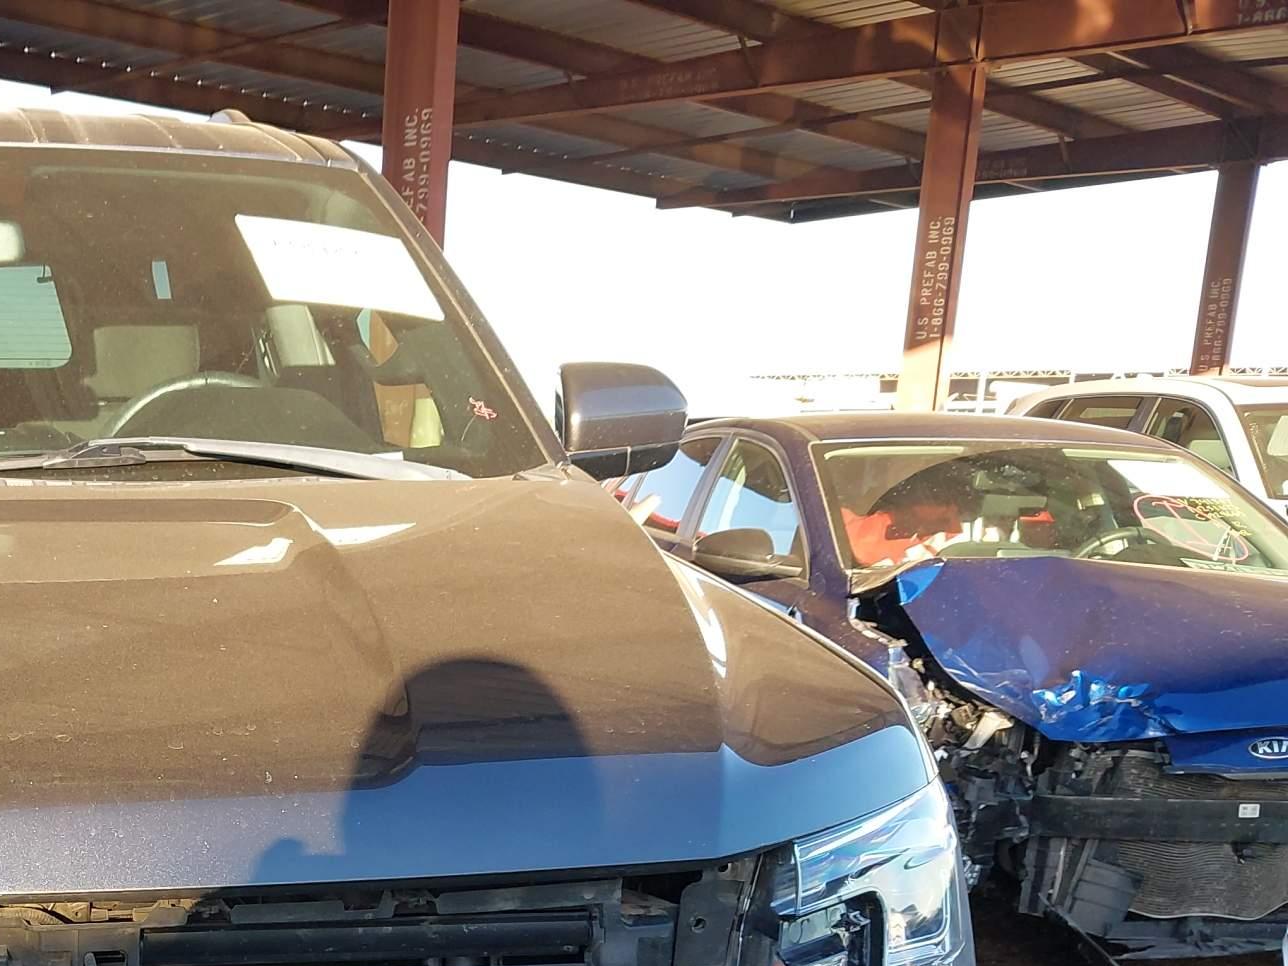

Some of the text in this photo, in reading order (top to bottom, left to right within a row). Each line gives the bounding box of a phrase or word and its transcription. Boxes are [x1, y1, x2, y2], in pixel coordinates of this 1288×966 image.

[404, 108, 419, 147] INC.
[927, 216, 943, 243] INC.
[920, 251, 937, 306] PREFAB
[929, 216, 955, 338] 1-866-799-0969
